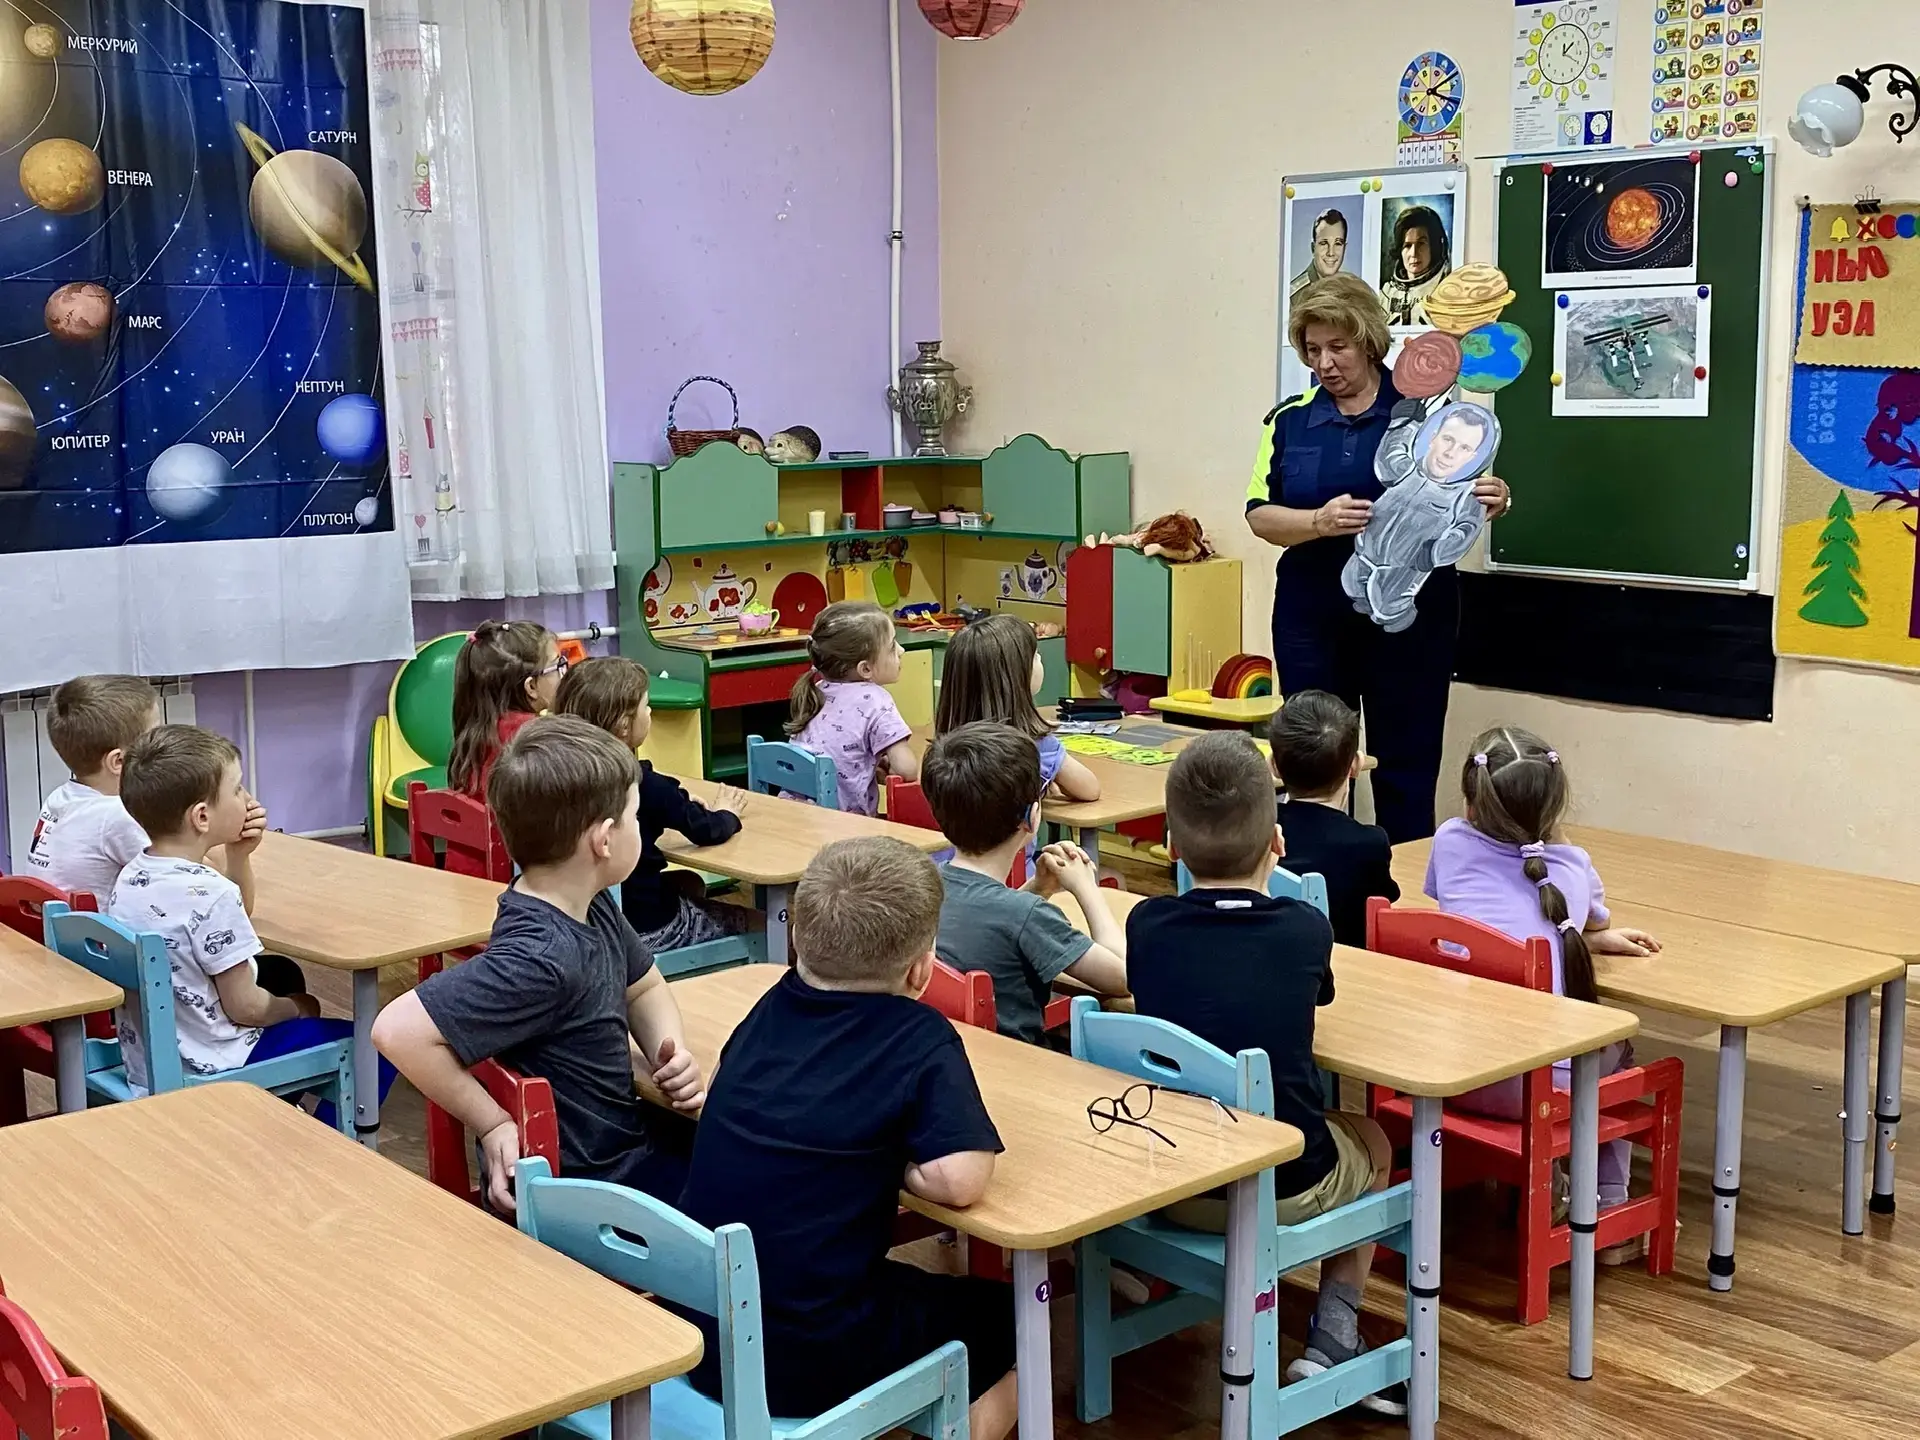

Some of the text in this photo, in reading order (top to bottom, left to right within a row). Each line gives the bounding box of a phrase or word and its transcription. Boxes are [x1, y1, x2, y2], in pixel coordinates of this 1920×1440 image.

[67, 35, 139, 55] МЕРКУРИЙ
[308, 130, 357, 146] САТУРН
[107, 169, 154, 188] ВЕНЕРА
[128, 315, 162, 330] МАРС
[1811, 299, 1876, 337] УЭА
[295, 379, 345, 394] НЕПТУН
[51, 434, 111, 451] ЮПИТЕР
[210, 429, 246, 444] УРАН
[302, 512, 354, 527] ПЛУТОН
[781, 912, 787, 921] 2
[1435, 1132, 1442, 1145] 2
[1041, 1284, 1049, 1301] 2
